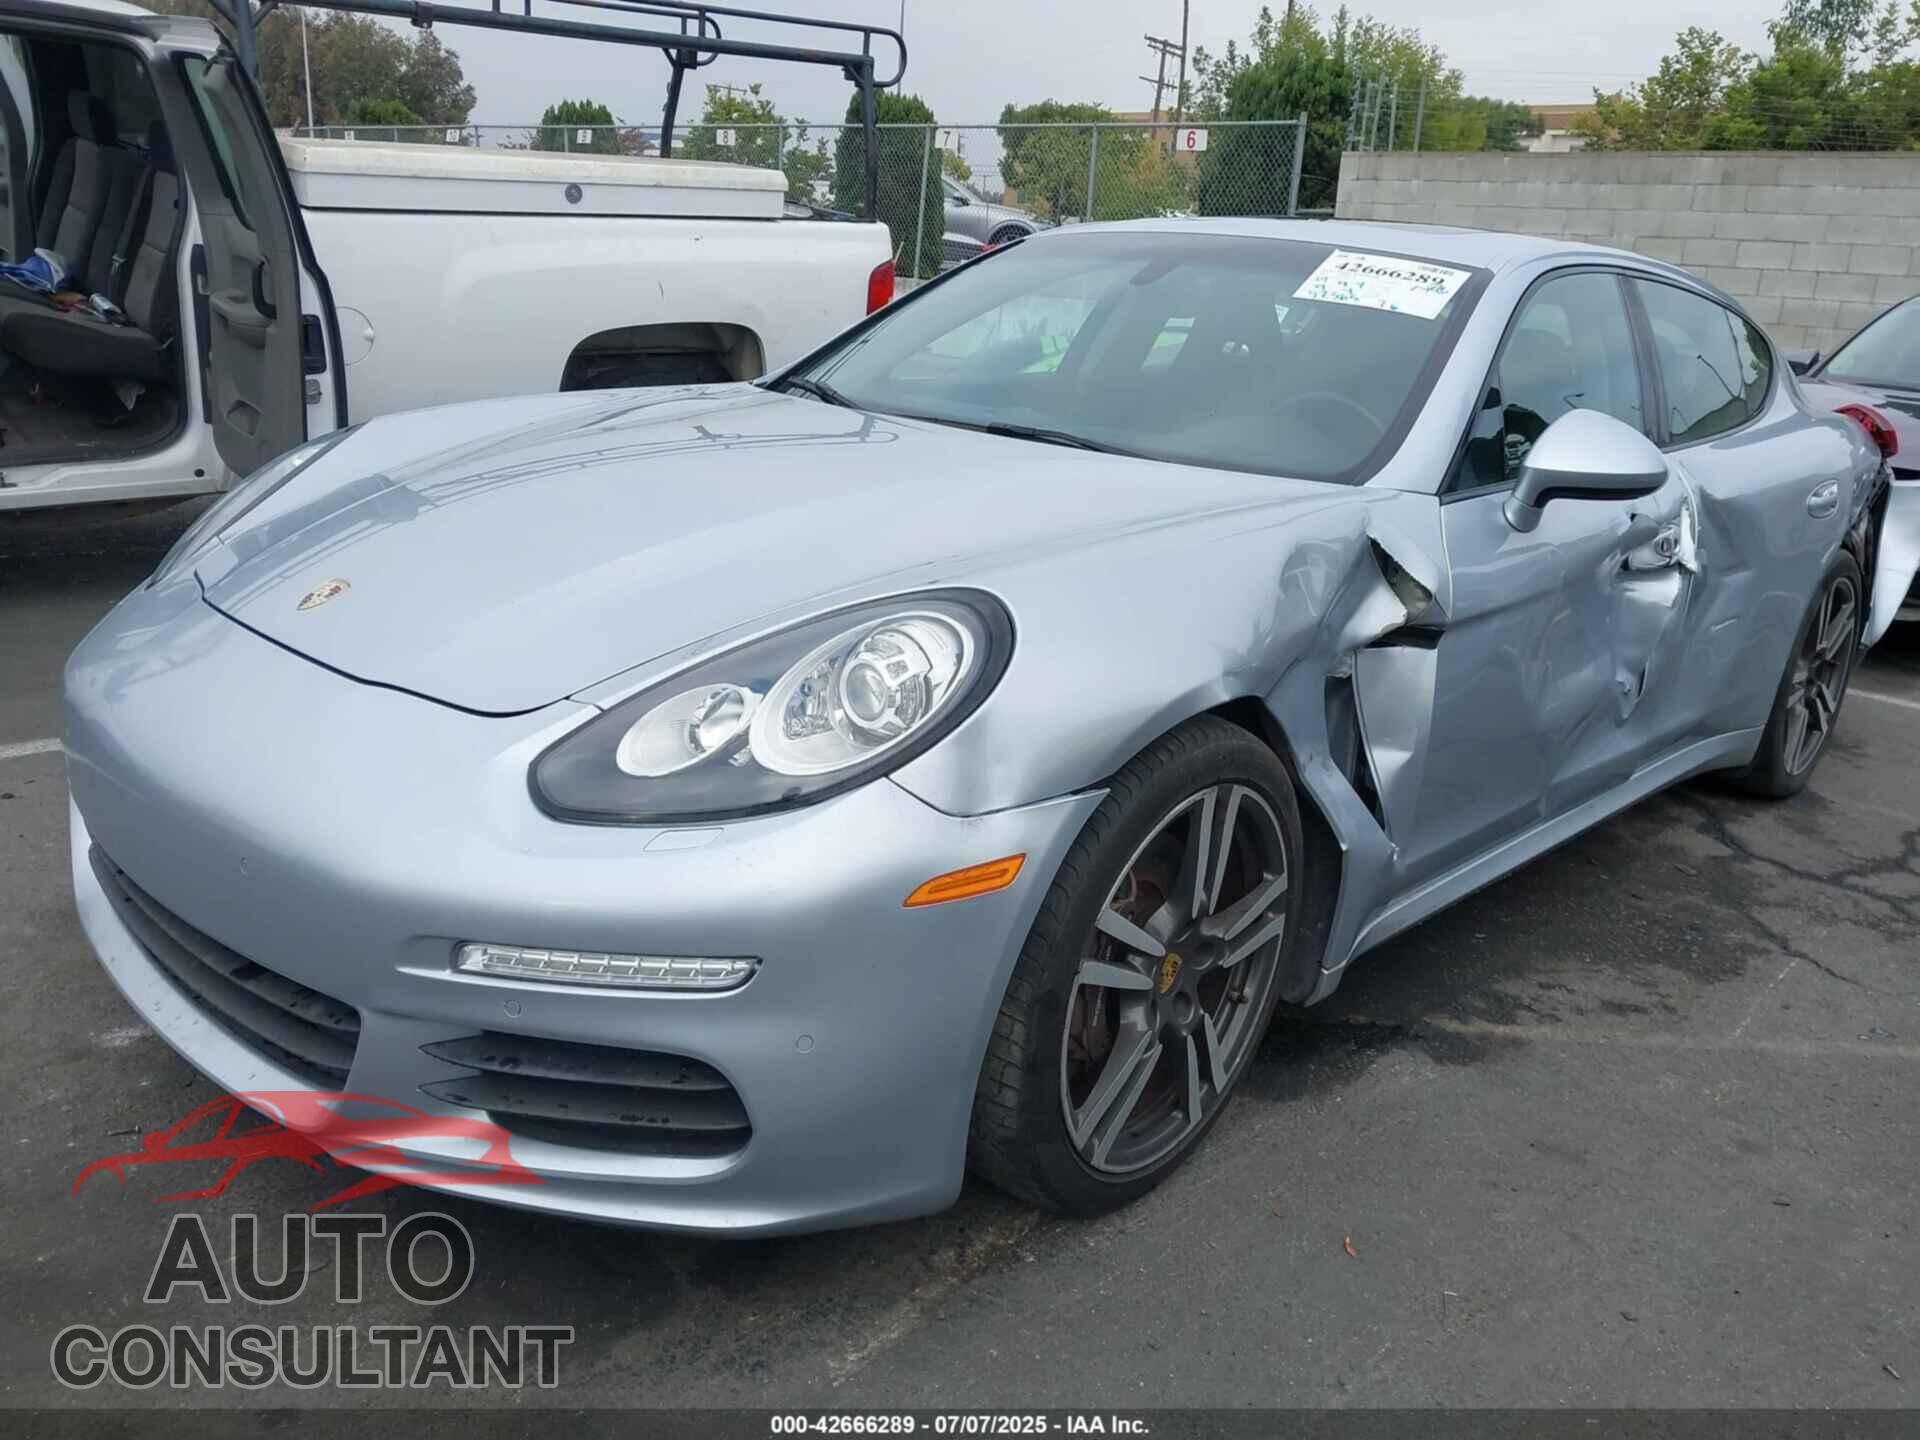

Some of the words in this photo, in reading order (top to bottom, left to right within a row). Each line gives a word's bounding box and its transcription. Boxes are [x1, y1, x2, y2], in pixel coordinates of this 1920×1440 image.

[723, 130, 729, 145] 8
[943, 130, 951, 147] 7
[1186, 130, 1196, 149] 6
[1335, 262, 1445, 285] 42666289
